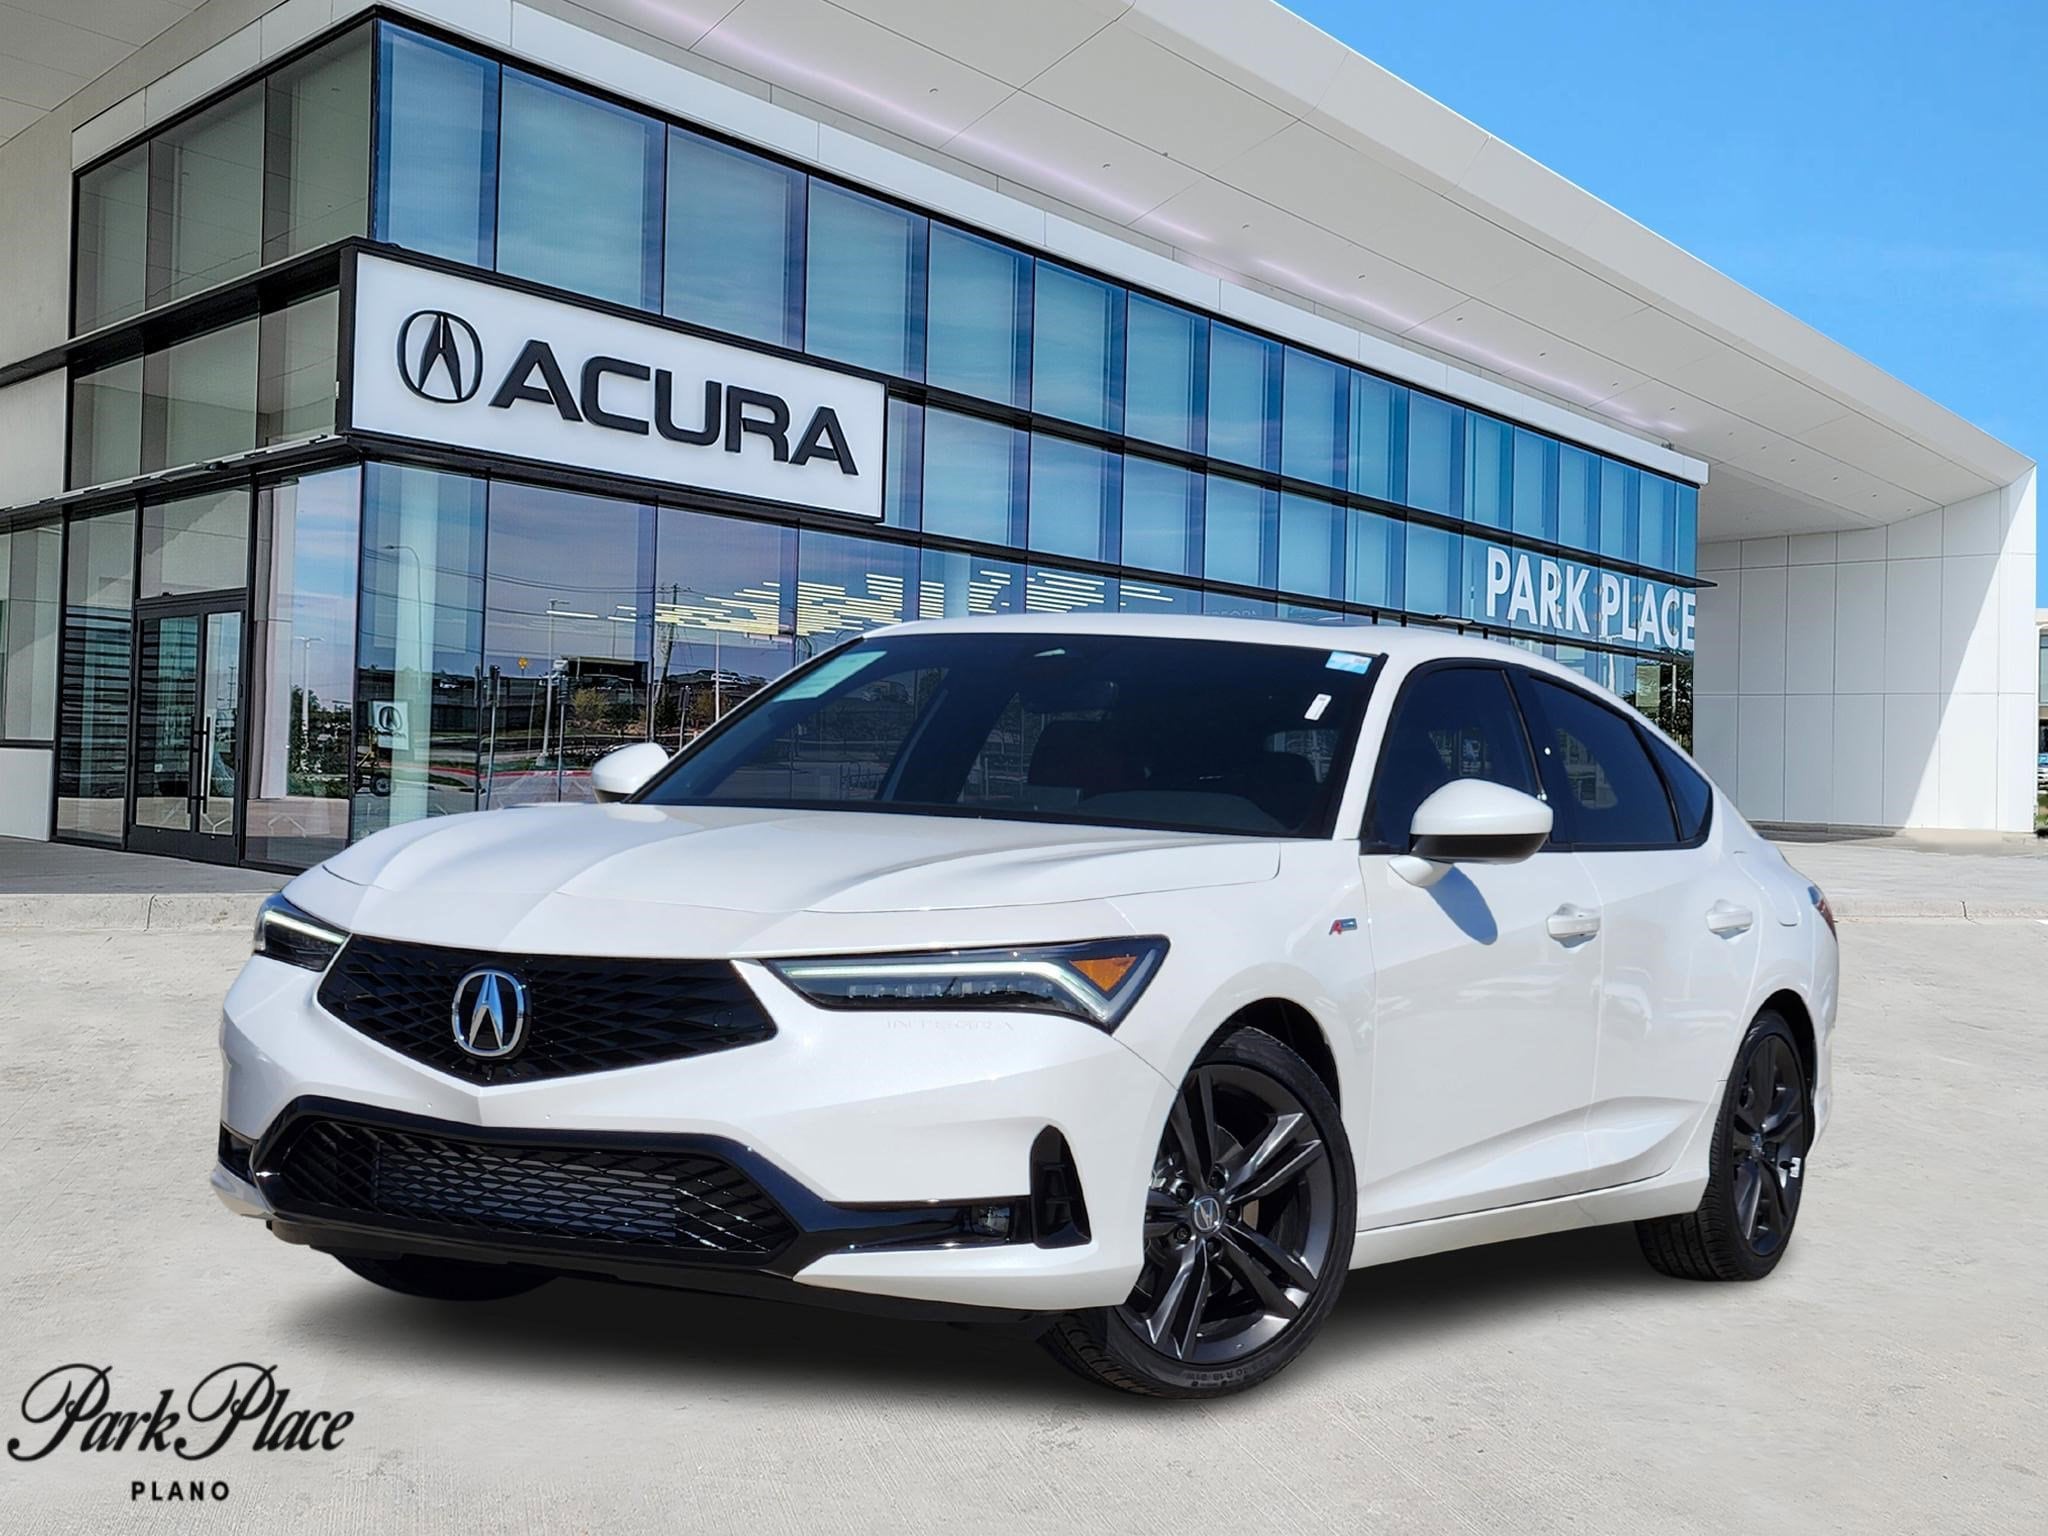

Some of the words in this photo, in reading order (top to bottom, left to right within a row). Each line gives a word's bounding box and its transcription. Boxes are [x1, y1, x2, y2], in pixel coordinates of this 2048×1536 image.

[488, 339, 859, 476] ACURA
[1486, 546, 1591, 634] PARK
[1600, 573, 1696, 650] PLACE
